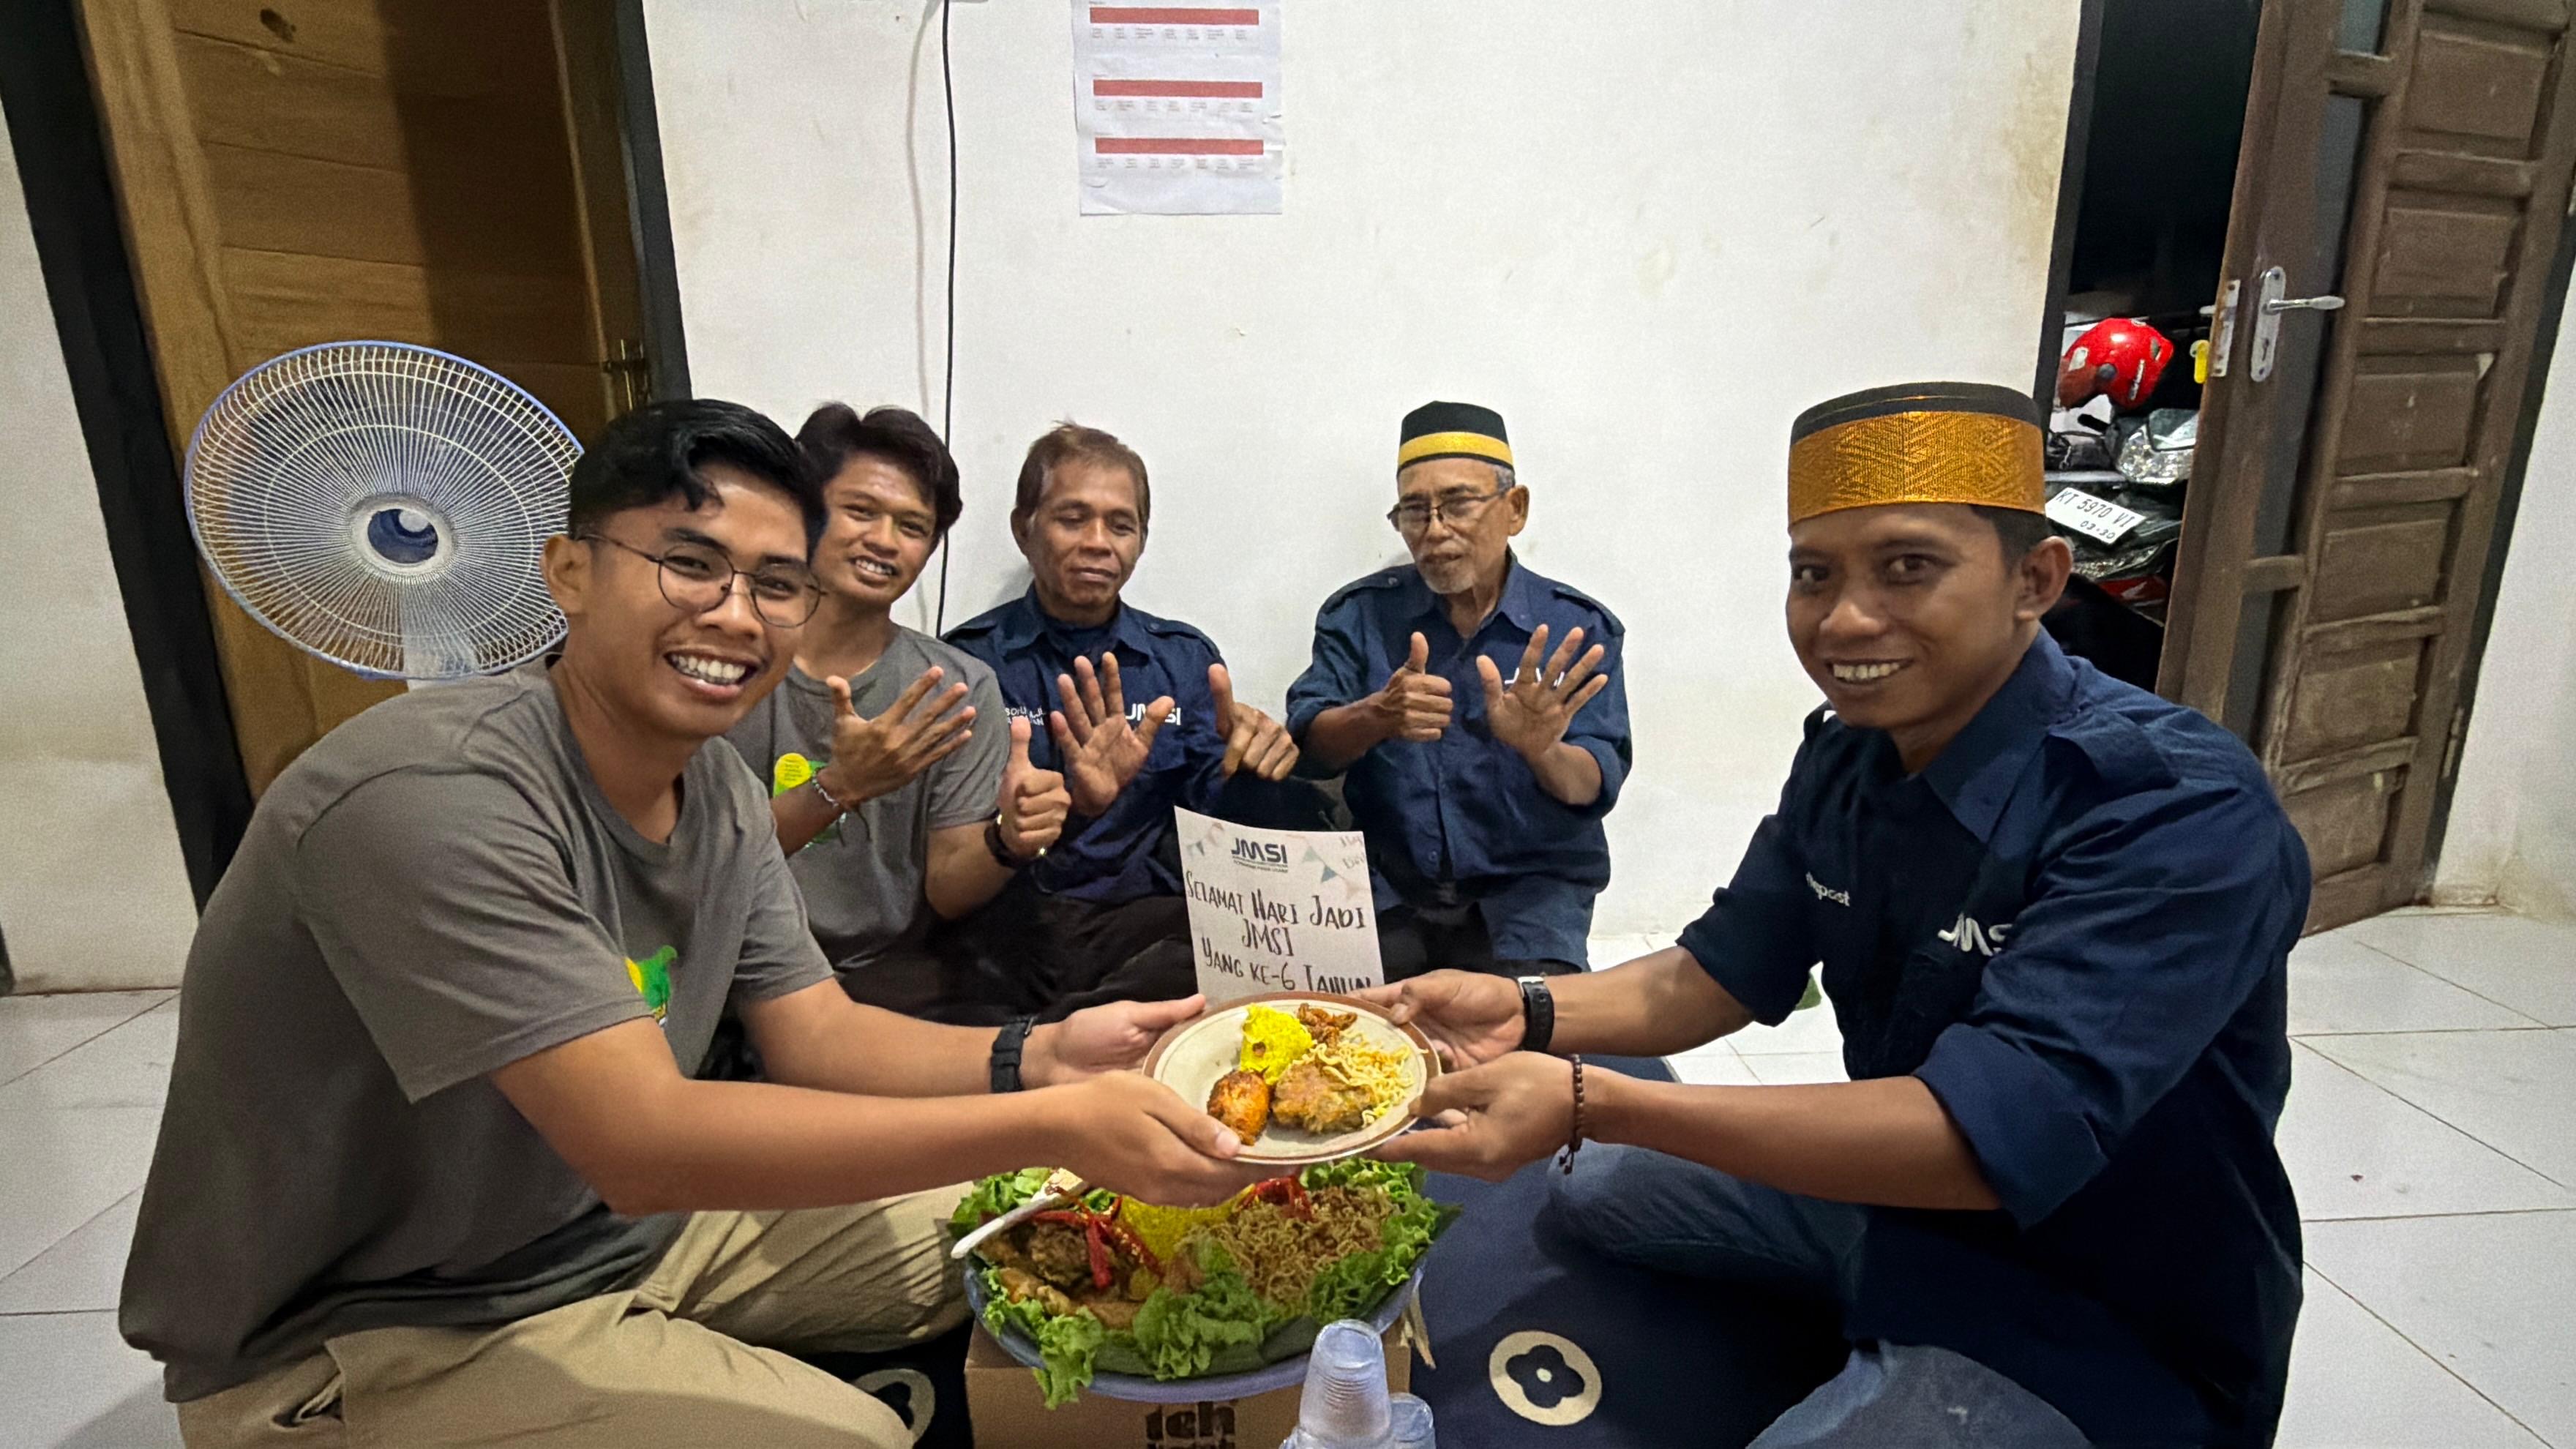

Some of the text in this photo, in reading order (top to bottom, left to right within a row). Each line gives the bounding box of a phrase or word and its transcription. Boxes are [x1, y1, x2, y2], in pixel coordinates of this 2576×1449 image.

[2056, 490, 2079, 505] KT
[2077, 498, 2113, 518] 5970
[1231, 837, 1288, 864] JMSI
[1186, 870, 1366, 929] SELAMAT HARI JADI
[1241, 918, 1295, 956] JMSI
[1202, 936, 1244, 978] YANG
[1249, 962, 1296, 991] KE-6
